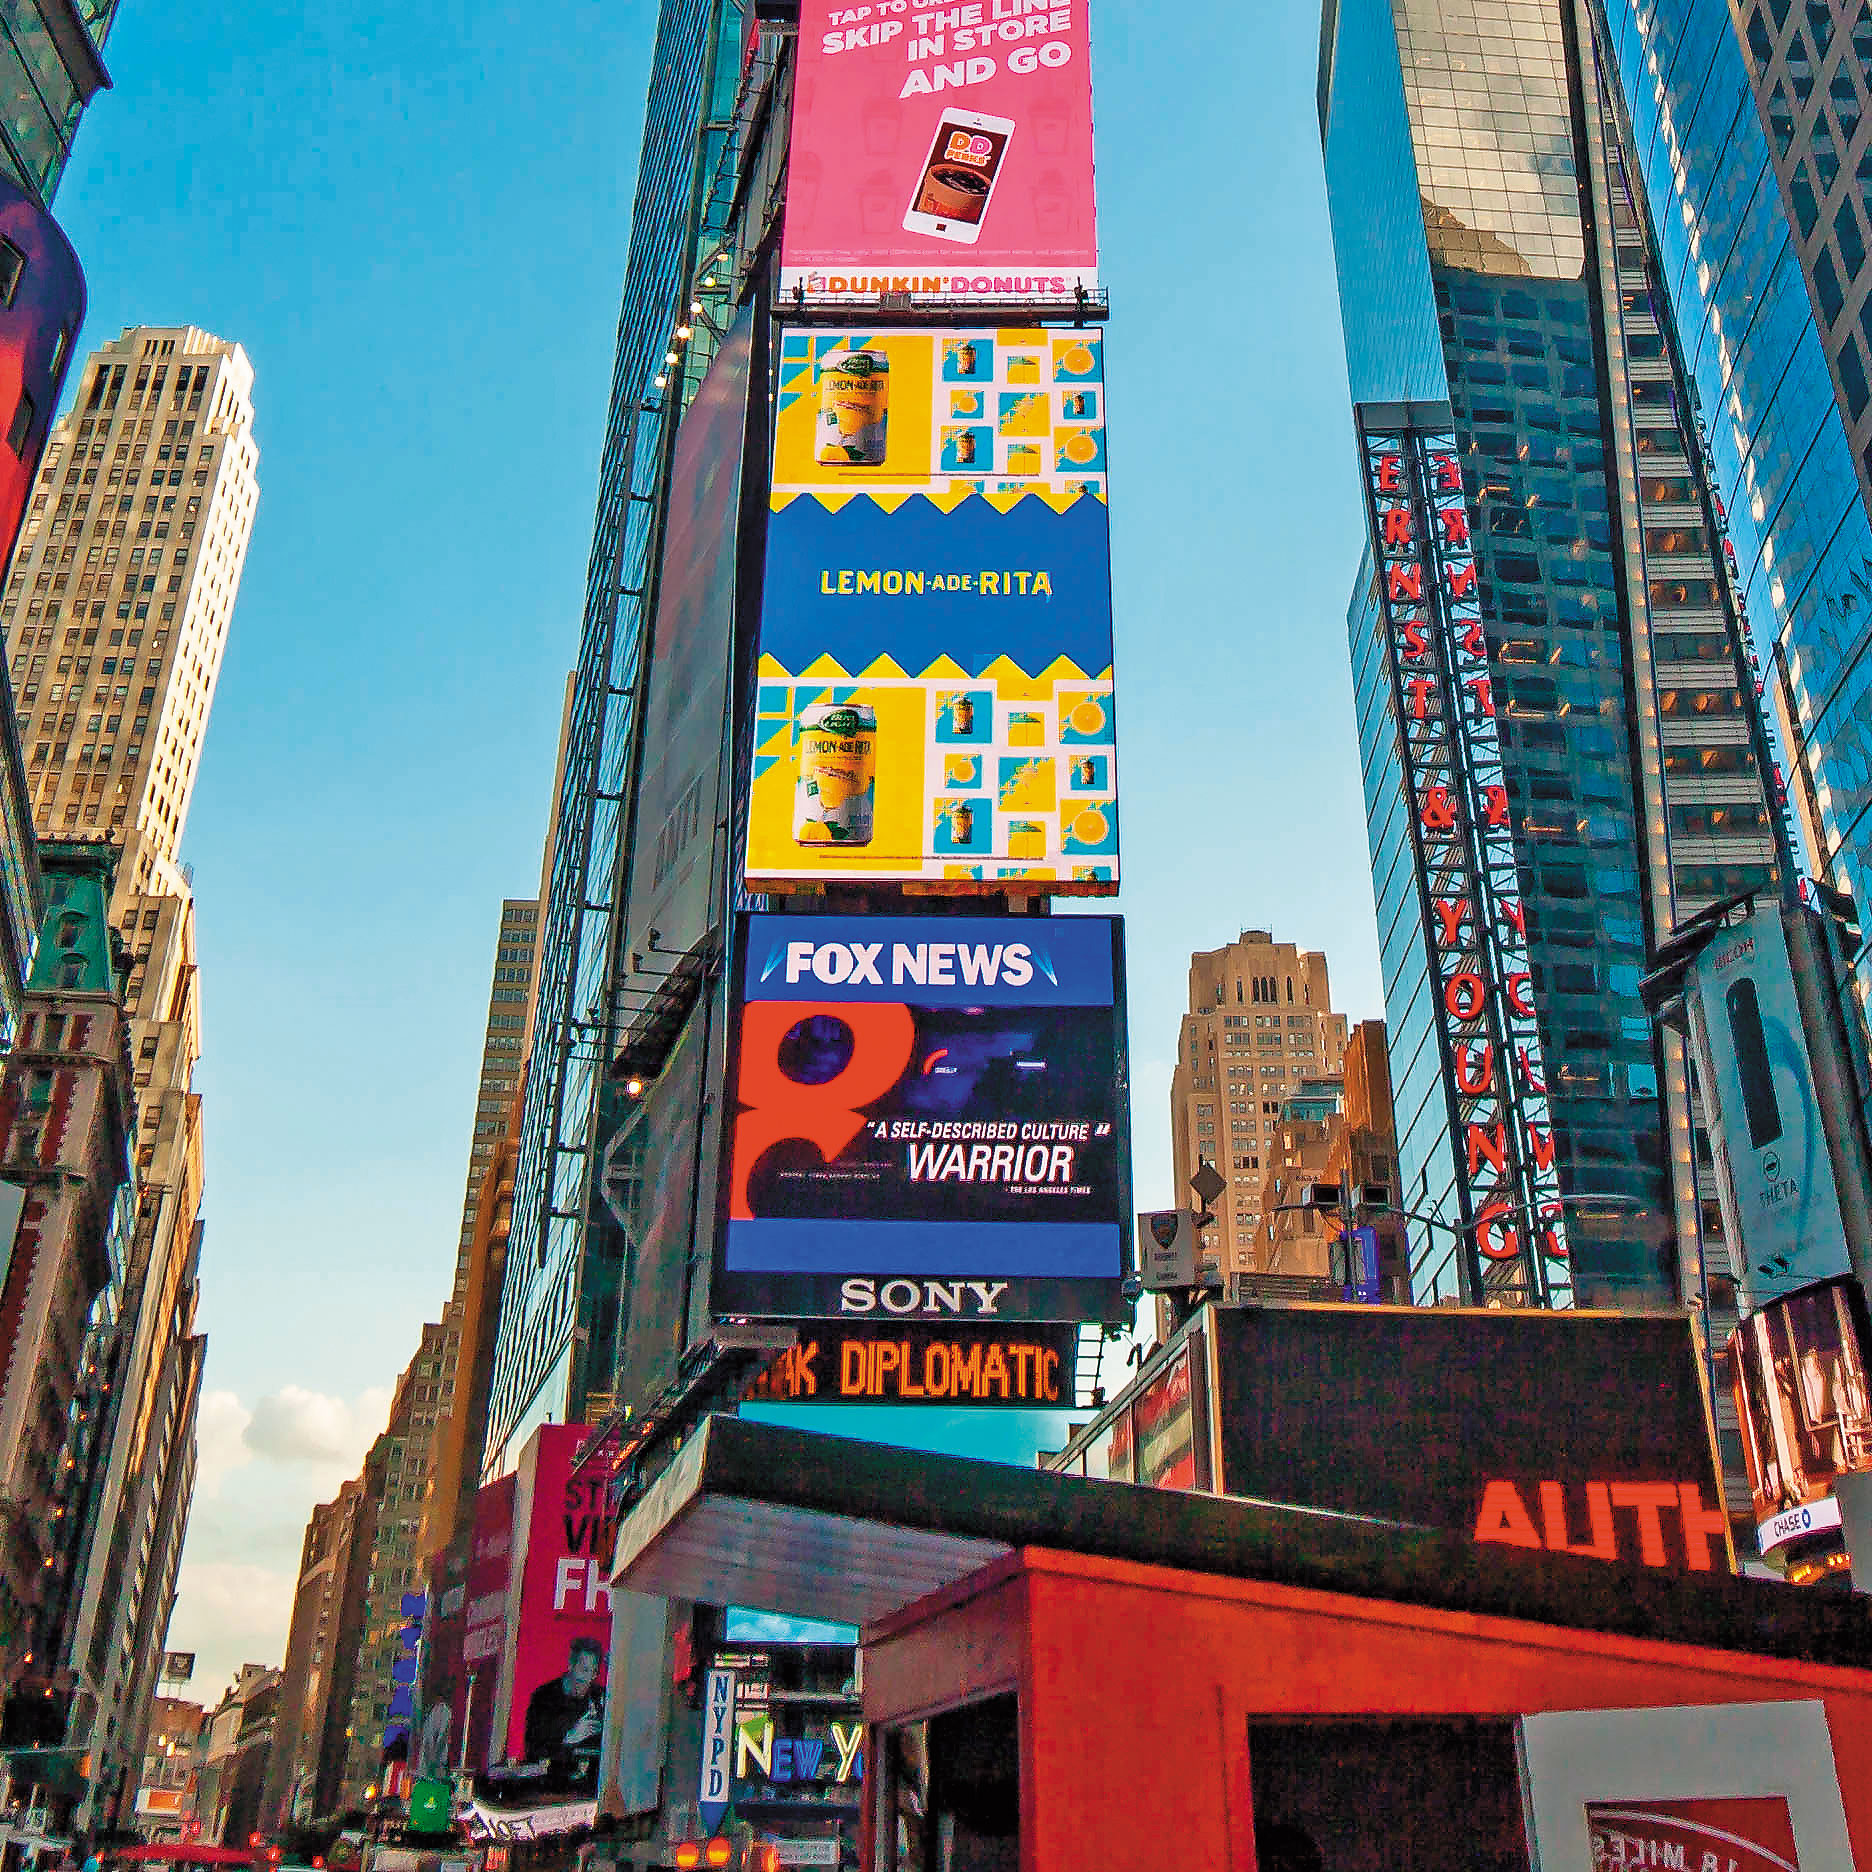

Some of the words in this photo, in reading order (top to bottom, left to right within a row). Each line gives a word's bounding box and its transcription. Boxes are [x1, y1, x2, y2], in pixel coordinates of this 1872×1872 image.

[822, 21, 902, 55] SKIP
[911, 3, 985, 37] THE
[828, 5, 871, 26] TAP
[877, 0, 907, 17] TO
[907, 35, 946, 62] IN
[951, 10, 1072, 50] STORE
[899, 57, 996, 99] AND
[1006, 42, 1072, 74] GO
[1379, 457, 1434, 719] ERNST
[1422, 786, 1457, 829] &
[786, 942, 884, 985] FOX
[892, 943, 1035, 986] NEWS
[1436, 898, 1520, 1259] YOUNG
[891, 1122, 1017, 1141] SELF-DESCRIBED
[1020, 1123, 1089, 1141] CULTURE
[909, 1144, 1075, 1182] WARRIOR
[839, 1278, 1009, 1314] SONY
[839, 1338, 1061, 1400] DIPLOMATIC
[1773, 1512, 1803, 1538] CHASE
[708, 1674, 732, 1798] NYPD
